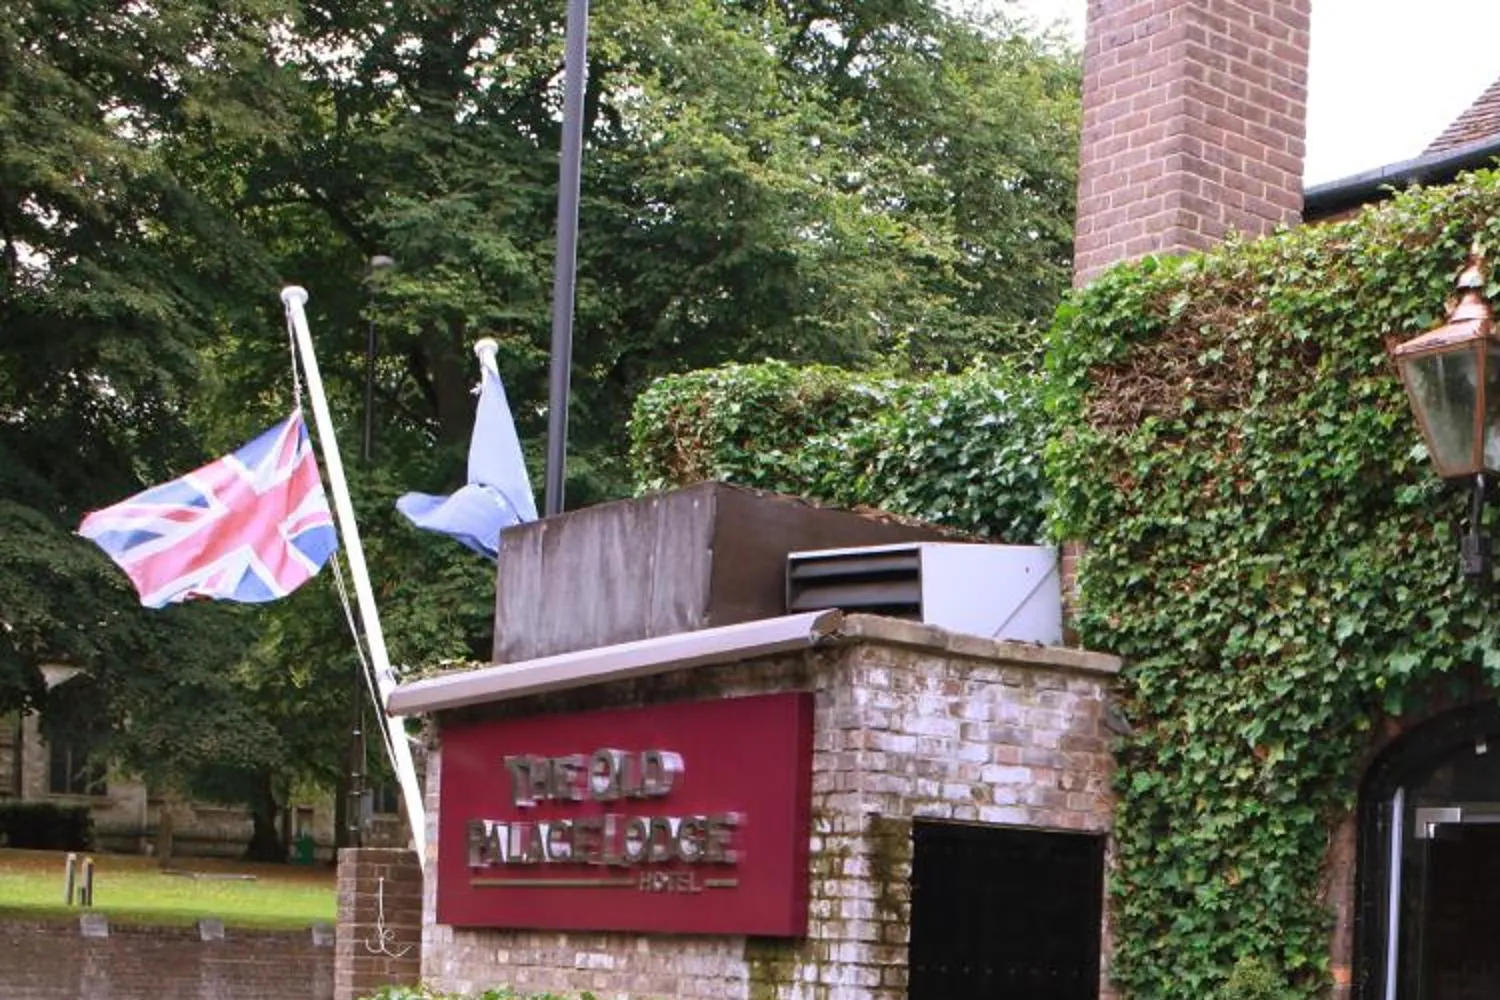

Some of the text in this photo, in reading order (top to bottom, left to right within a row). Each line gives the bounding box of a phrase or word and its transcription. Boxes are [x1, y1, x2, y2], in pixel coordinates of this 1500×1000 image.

[505, 747, 686, 807] THE OLD
[467, 812, 747, 868] PALACE LODGE
[638, 871, 705, 896] HOTEL
